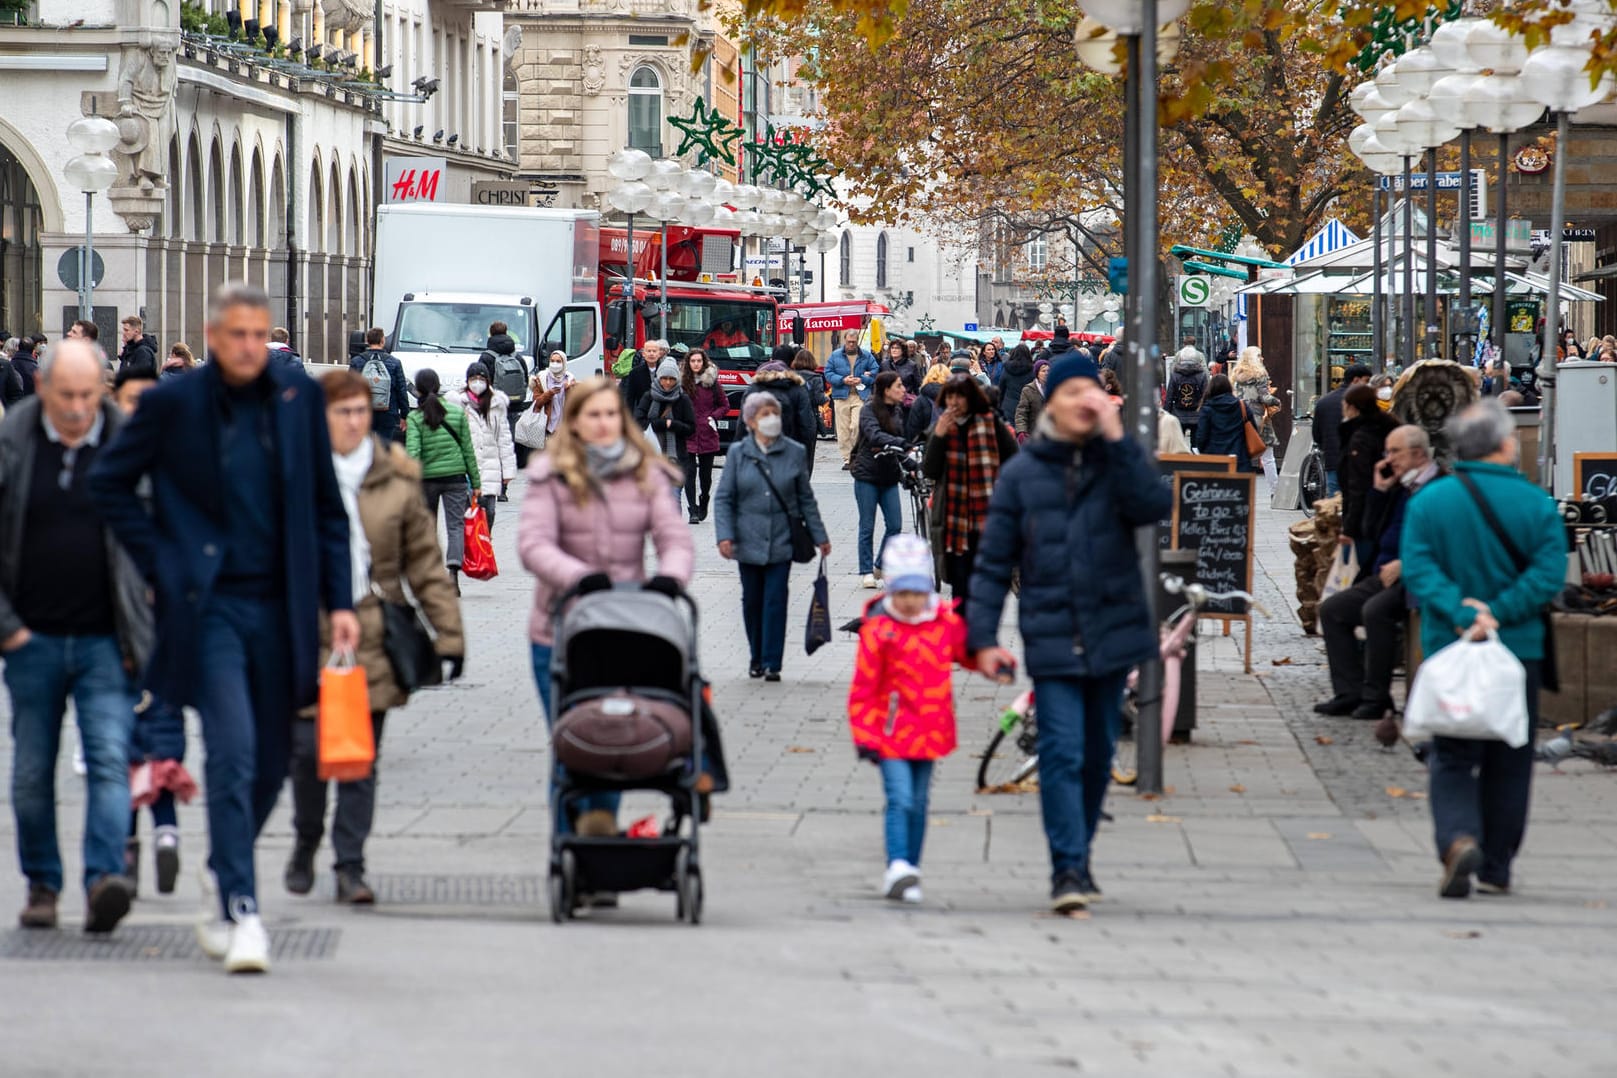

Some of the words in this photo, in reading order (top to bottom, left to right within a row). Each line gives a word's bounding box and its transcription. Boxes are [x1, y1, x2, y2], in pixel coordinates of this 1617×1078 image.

[392, 168, 441, 202] H&M
[478, 190, 526, 204] CHRIST
[1185, 279, 1205, 303] S
[1192, 503, 1209, 518] to
[1211, 507, 1231, 521] go
